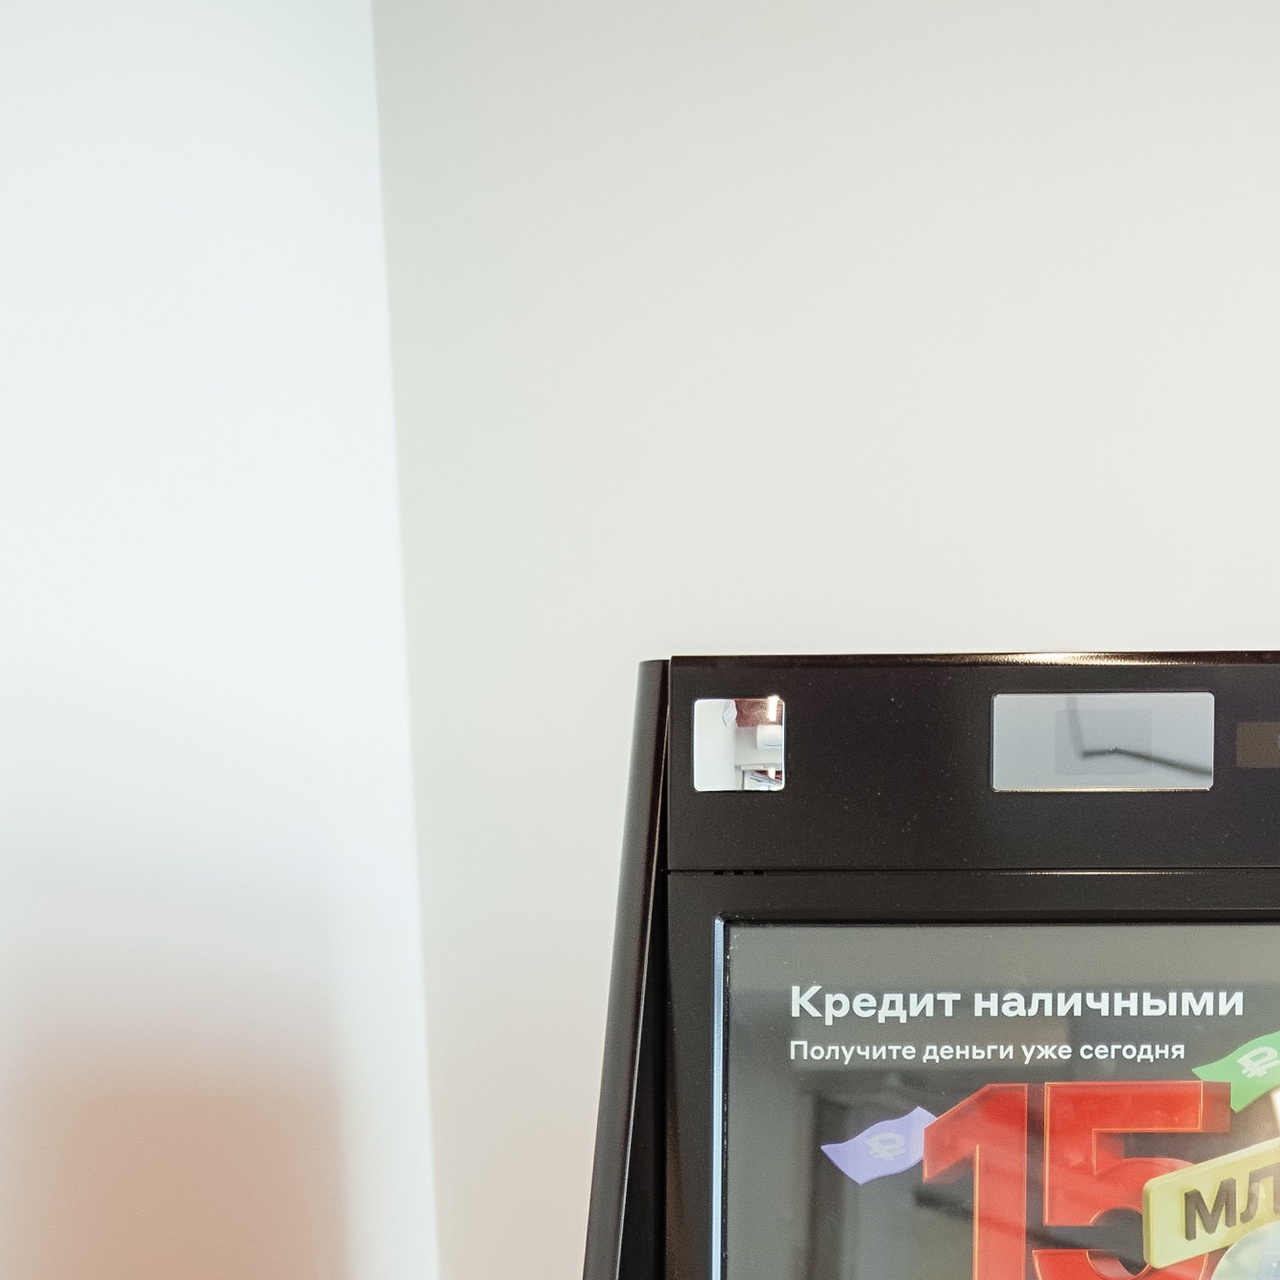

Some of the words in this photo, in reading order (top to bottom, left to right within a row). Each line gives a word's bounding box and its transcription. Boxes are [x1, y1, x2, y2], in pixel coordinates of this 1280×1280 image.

[790, 985, 962, 1025] Кредит
[973, 991, 1245, 1018] наличными
[789, 1040, 917, 1064] Получите
[922, 1042, 1014, 1064] деньги
[1021, 1043, 1073, 1064] уже
[1079, 1043, 1185, 1063] сегодня
